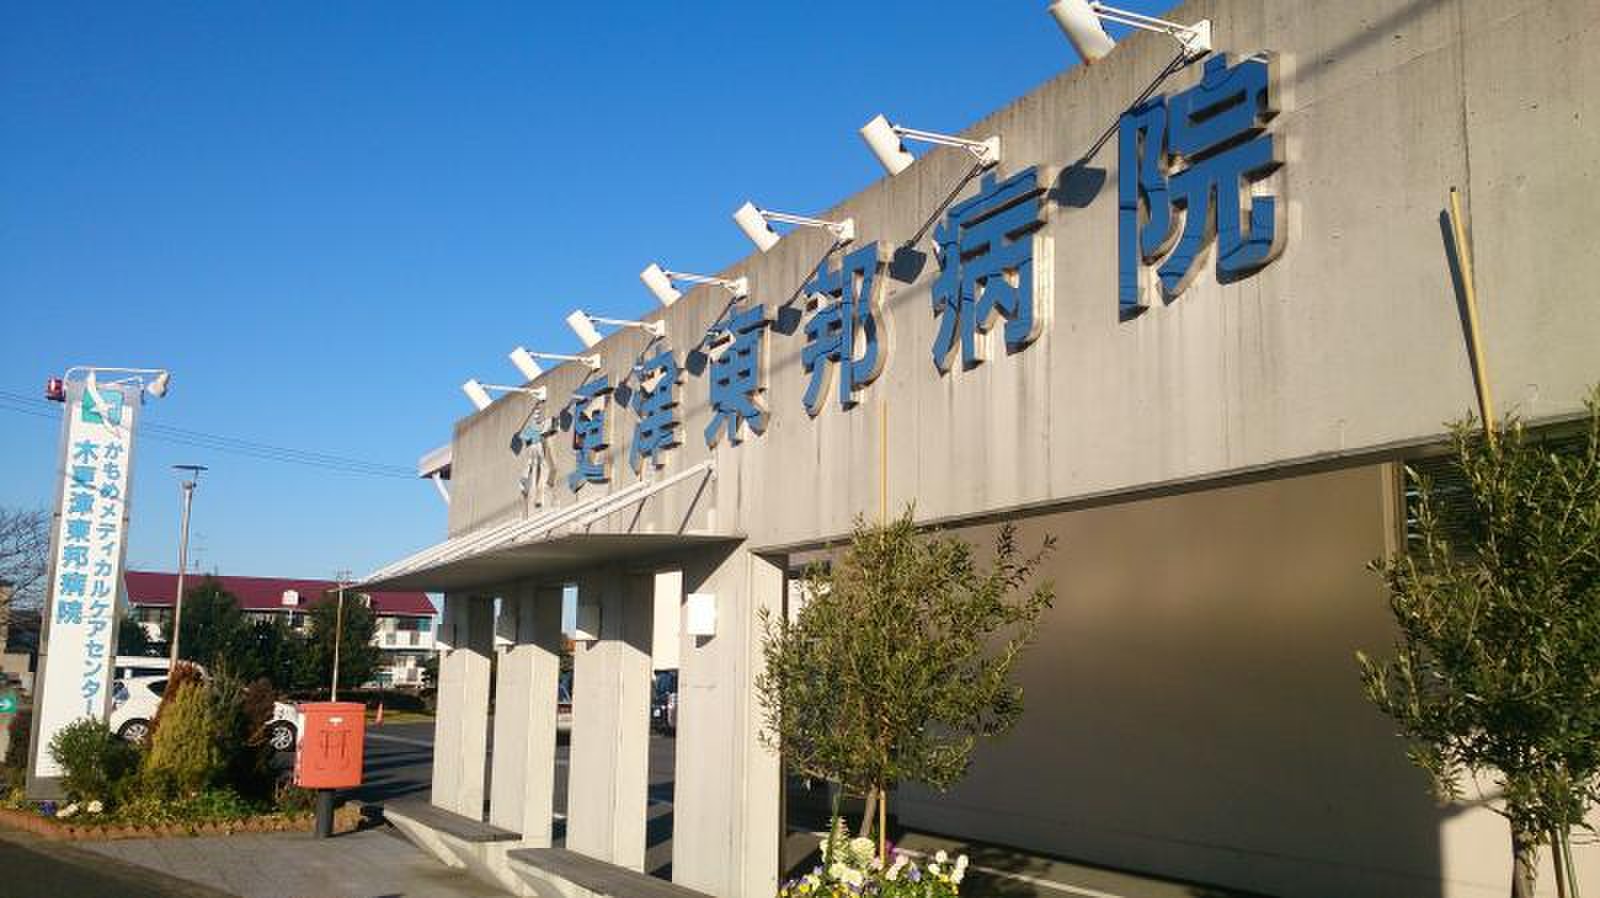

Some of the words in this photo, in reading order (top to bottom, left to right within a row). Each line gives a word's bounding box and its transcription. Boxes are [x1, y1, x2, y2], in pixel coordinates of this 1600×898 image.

[56, 439, 98, 624] 木更津東邦病院
[82, 441, 123, 714] かもめメディカルケアセンター
